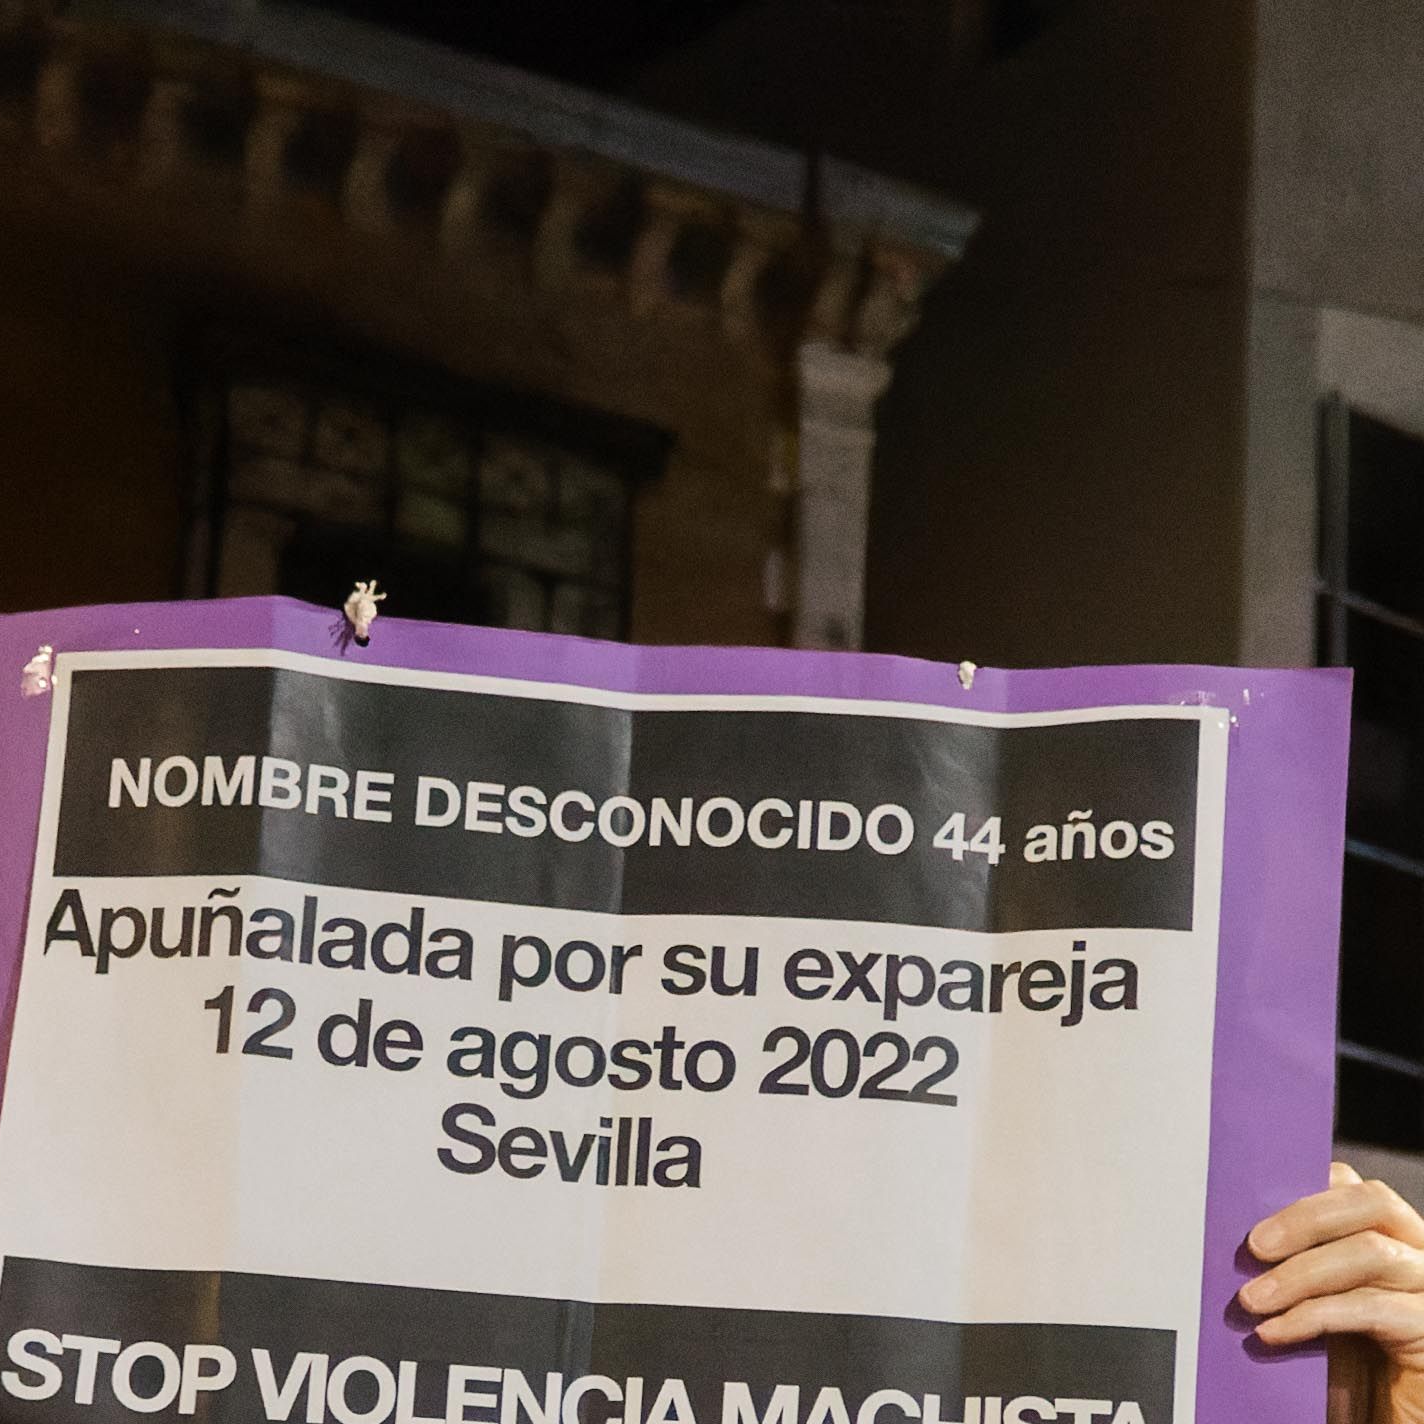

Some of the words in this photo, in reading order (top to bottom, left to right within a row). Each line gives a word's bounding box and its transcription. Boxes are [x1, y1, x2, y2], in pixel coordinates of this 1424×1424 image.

[108, 755, 395, 822] NOMBRE
[414, 776, 914, 854] DESCONOCIDO
[932, 813, 1005, 865] 44
[1023, 809, 1175, 862] años
[43, 887, 474, 981] Apuñalada
[497, 933, 642, 1002] por
[661, 942, 759, 997] su
[783, 940, 1139, 1027] expareja
[204, 985, 297, 1061] 12
[317, 998, 424, 1072] de
[446, 1025, 736, 1098] agosto
[758, 1026, 959, 1107] 2022
[436, 1102, 703, 1188] Sevilla
[0, 1328, 237, 1415] STOP
